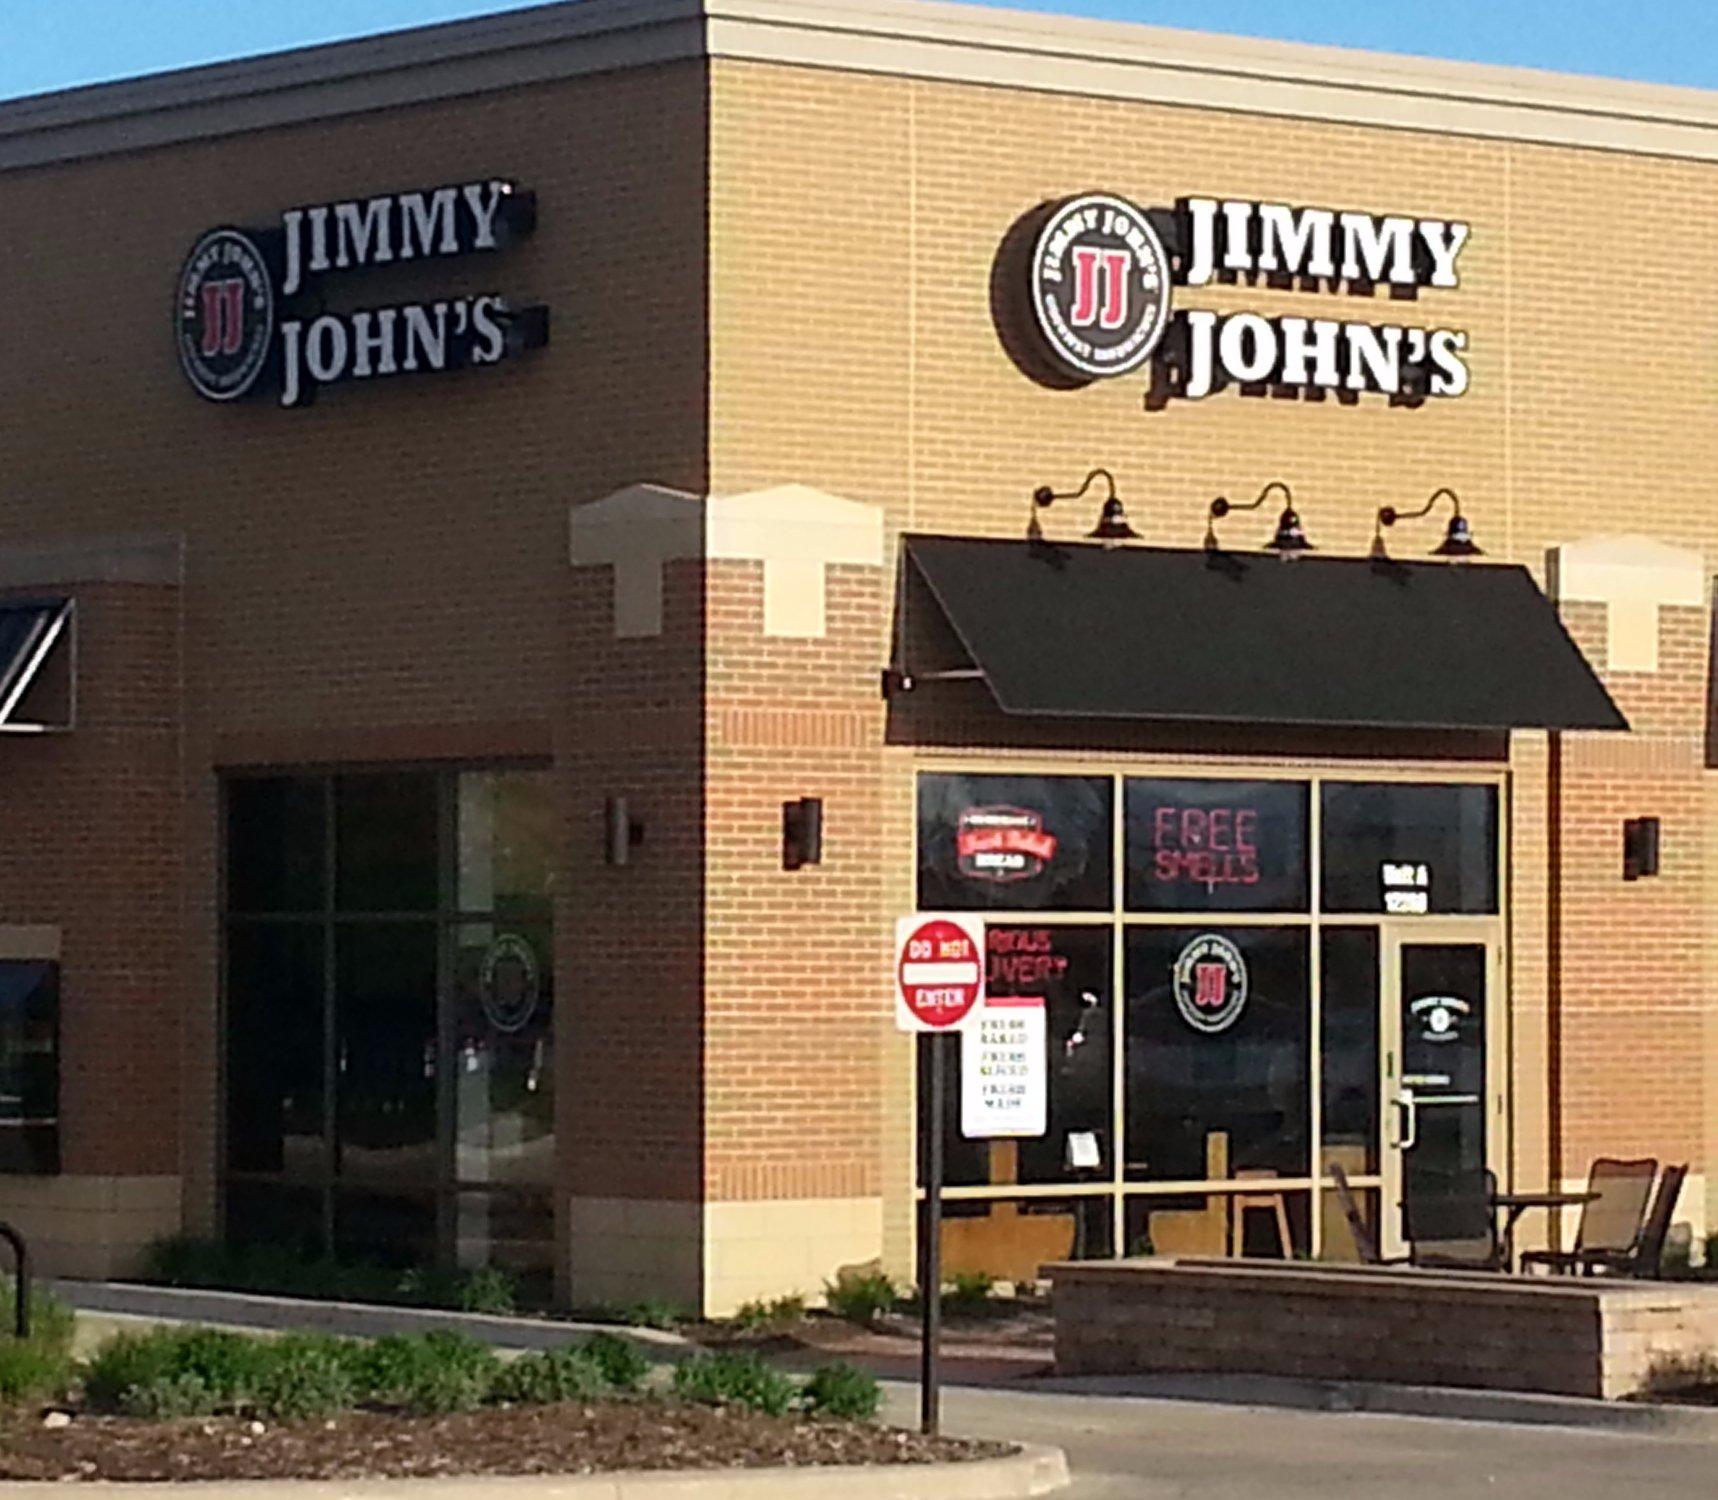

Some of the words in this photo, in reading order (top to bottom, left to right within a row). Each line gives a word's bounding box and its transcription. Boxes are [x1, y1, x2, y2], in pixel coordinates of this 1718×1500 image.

[282, 180, 509, 295] JIMMY
[1043, 208, 1099, 282] JIMMY
[1187, 198, 1470, 288] JIMMY
[1070, 246, 1132, 330] JJ
[281, 296, 508, 407] JOHN'S
[1186, 310, 1469, 398] JOHN'S
[1155, 807, 1257, 851] FREE
[1155, 850, 1260, 884] SMELLS
[909, 939, 932, 960] DO
[939, 939, 970, 959] NOT
[915, 988, 965, 1009] ENTER
